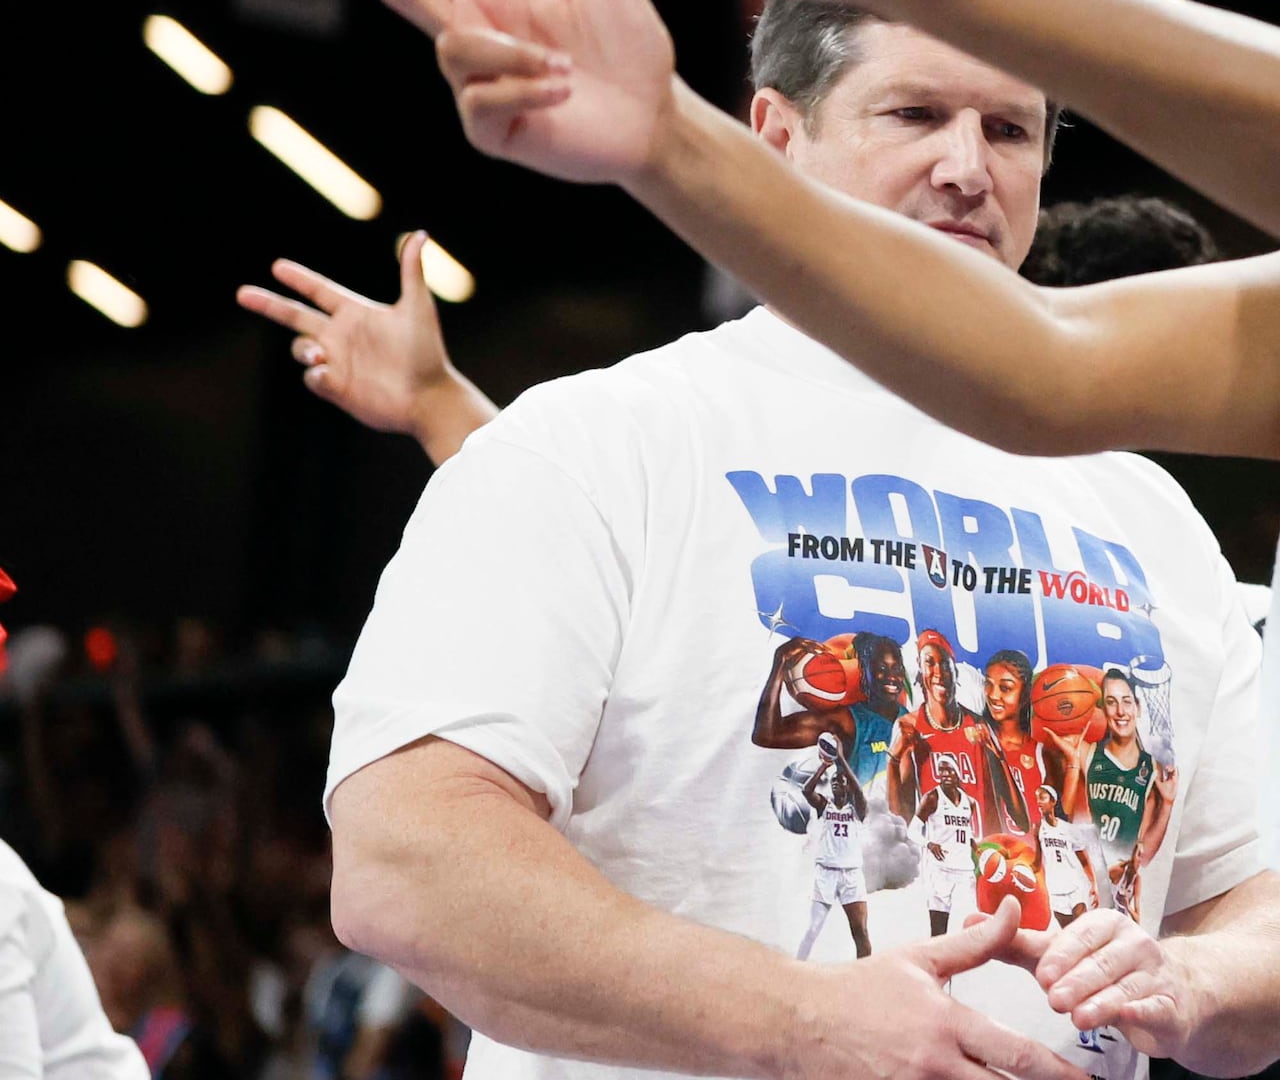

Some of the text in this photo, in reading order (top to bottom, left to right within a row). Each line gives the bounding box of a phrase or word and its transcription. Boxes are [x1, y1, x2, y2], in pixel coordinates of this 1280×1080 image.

[725, 470, 1150, 596] WORLD
[788, 533, 864, 562] FROM
[870, 539, 916, 570] THE
[952, 560, 977, 591] TO
[983, 567, 1032, 594] THE
[1038, 571, 1130, 612] WORLD
[750, 546, 1165, 672] CUP
[930, 752, 976, 785] UA
[826, 810, 854, 821] DREAM
[1100, 814, 1121, 842] 20
[834, 823, 848, 837] 23
[955, 829, 966, 844] 10
[1055, 849, 1062, 863] 5
